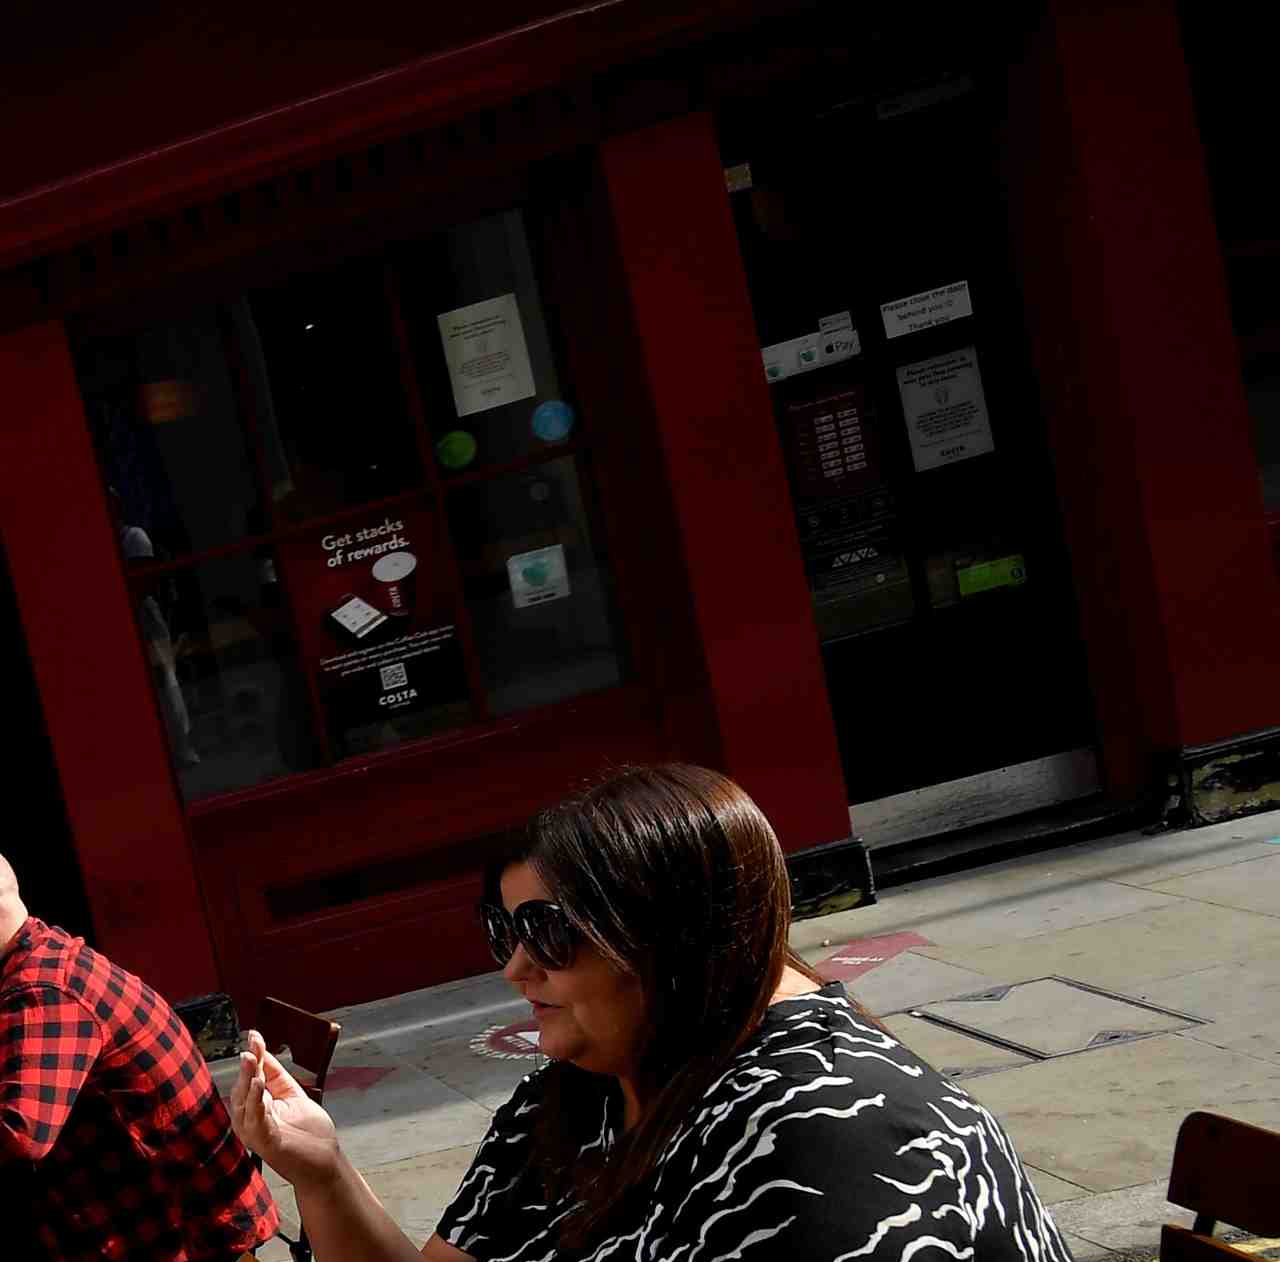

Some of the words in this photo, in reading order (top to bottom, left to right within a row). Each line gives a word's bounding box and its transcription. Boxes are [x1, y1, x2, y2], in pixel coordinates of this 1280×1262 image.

[321, 533, 353, 551] Get
[356, 517, 405, 543] stacks
[326, 549, 345, 568] of
[377, 688, 419, 706] COSTA
